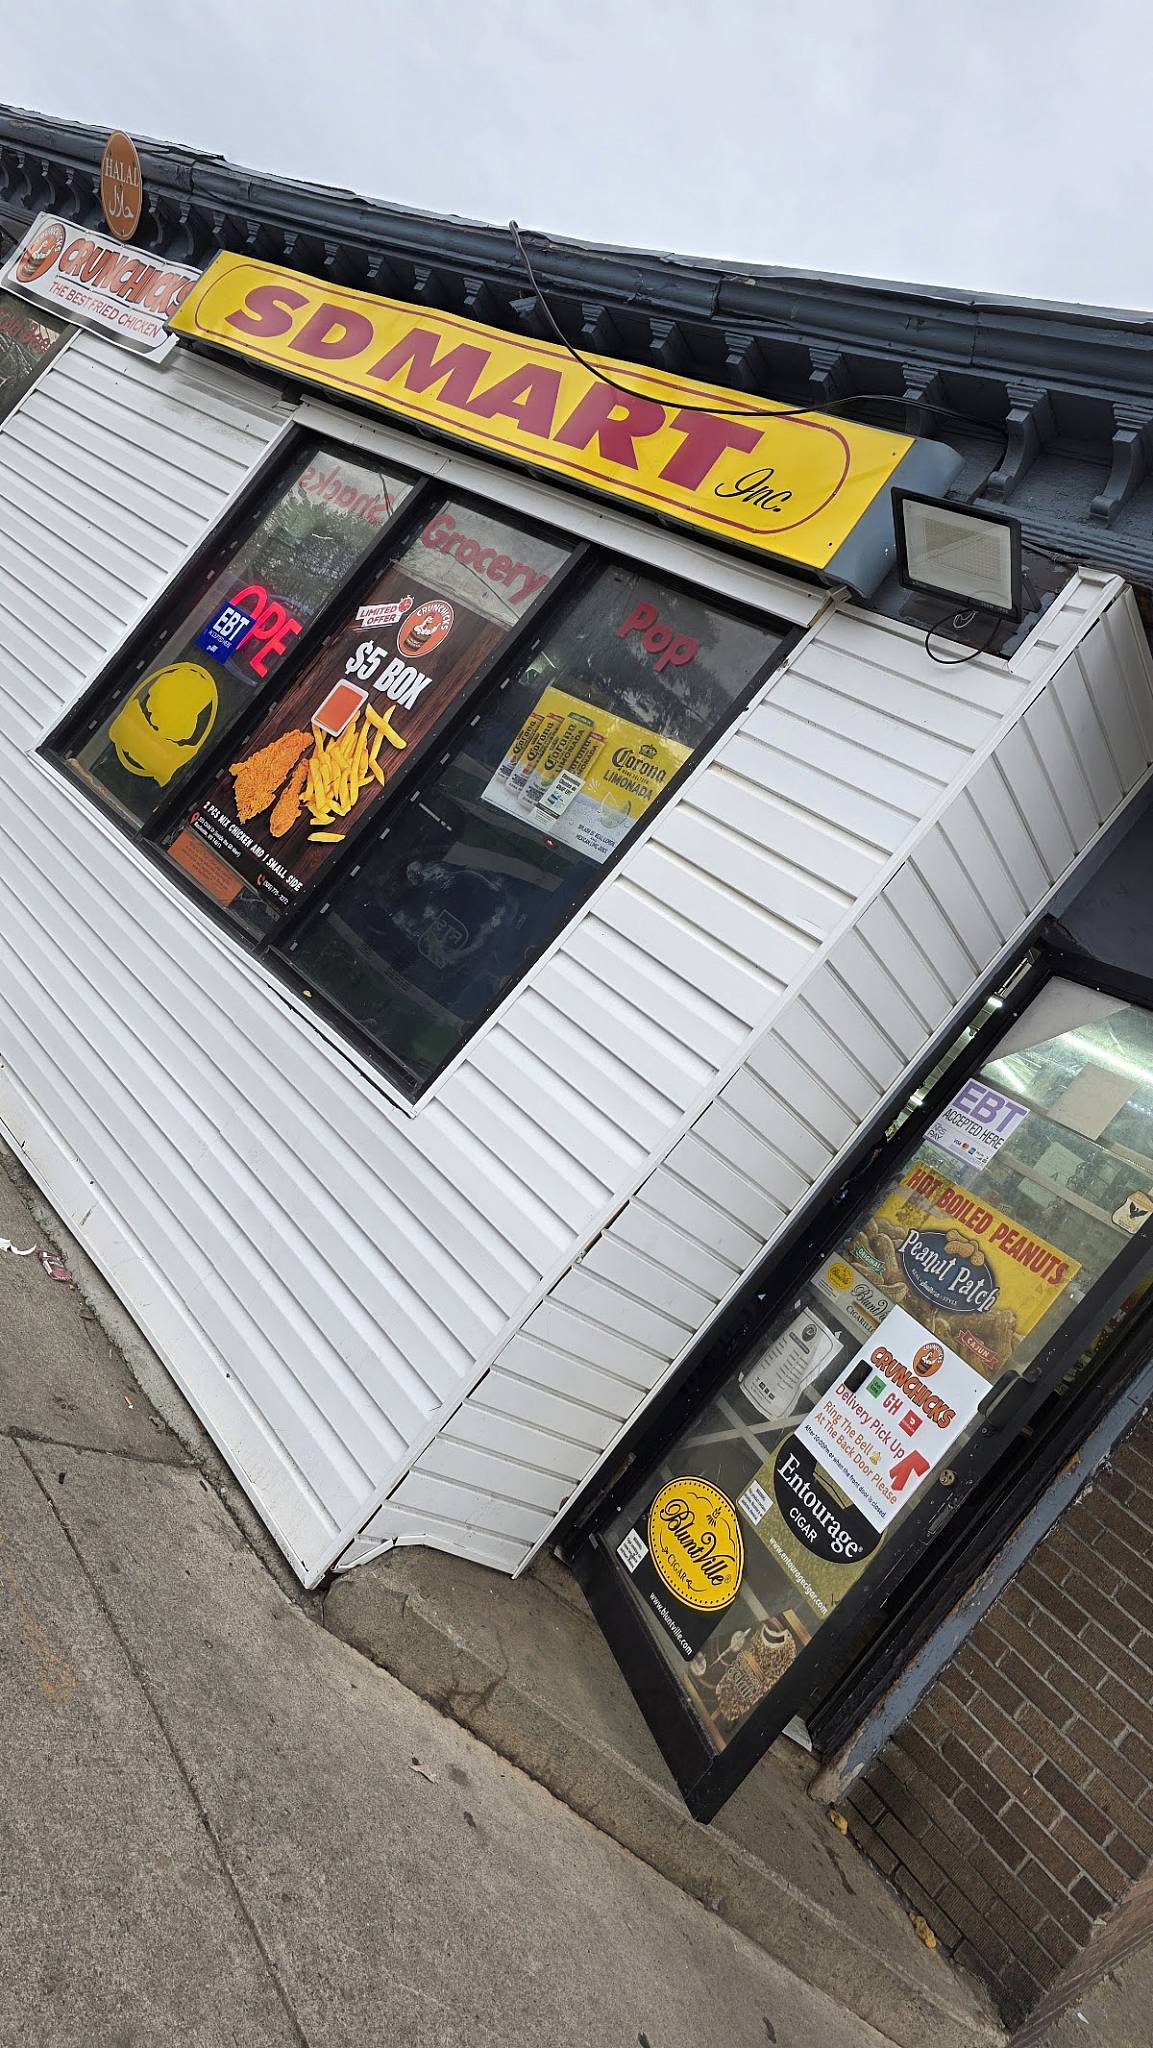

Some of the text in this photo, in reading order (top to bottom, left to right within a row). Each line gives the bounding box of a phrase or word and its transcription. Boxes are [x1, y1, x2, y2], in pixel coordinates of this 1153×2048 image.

[105, 157, 140, 187] HALAL
[50, 281, 161, 339] THE BEST FRIED CHICKEN
[225, 285, 765, 492] SD MART
[714, 467, 793, 513] Inc.
[420, 513, 548, 605] Grocery
[212, 606, 251, 641] EBT
[360, 605, 397, 618] LIMITED
[367, 614, 396, 625] OFFER
[416, 603, 451, 631] CRUNCHICKS
[616, 602, 698, 673] Pop
[345, 640, 433, 711] $5 BOX
[527, 722, 554, 762] Corona
[544, 723, 577, 771] Corona
[612, 747, 667, 783] Corona
[603, 769, 653, 801] LIMONADA
[203, 801, 211, 809] 2
[207, 805, 221, 818] PCS
[217, 815, 231, 828] MIX
[228, 824, 254, 848] CHICKEN
[250, 844, 265, 857] AND
[266, 857, 288, 879] SMALL
[285, 875, 303, 892] SIDE
[942, 1108, 1005, 1150] ACCEPTED HERE
[952, 1080, 1028, 1133] EBT
[927, 1129, 944, 1141] PAY
[906, 1168, 1070, 1285] HOT BOILED PEANUTS
[857, 1247, 881, 1269] ORIGINAL
[898, 1229, 957, 1281] Peanut
[948, 1266, 1001, 1313] Patch
[966, 1337, 990, 1358] CAJUN
[870, 1346, 957, 1429] CRUNCHICKS
[882, 1392, 904, 1415] GH
[823, 1401, 873, 1456] Ring The Bell
[835, 1383, 905, 1459] Delivery Pick Up
[804, 1425, 815, 1437] After
[832, 1456, 844, 1471] when
[849, 1474, 860, 1488] front
[858, 1486, 869, 1498] door
[871, 1501, 887, 1519] closed.
[815, 1412, 897, 1504] At The Back Door Please
[789, 1507, 818, 1544] CIGAR
[667, 1553, 688, 1583] CIGAR
[768, 1537, 829, 1616] www.entouragecigar.com
[649, 1591, 694, 1657] www.bluntville.com
